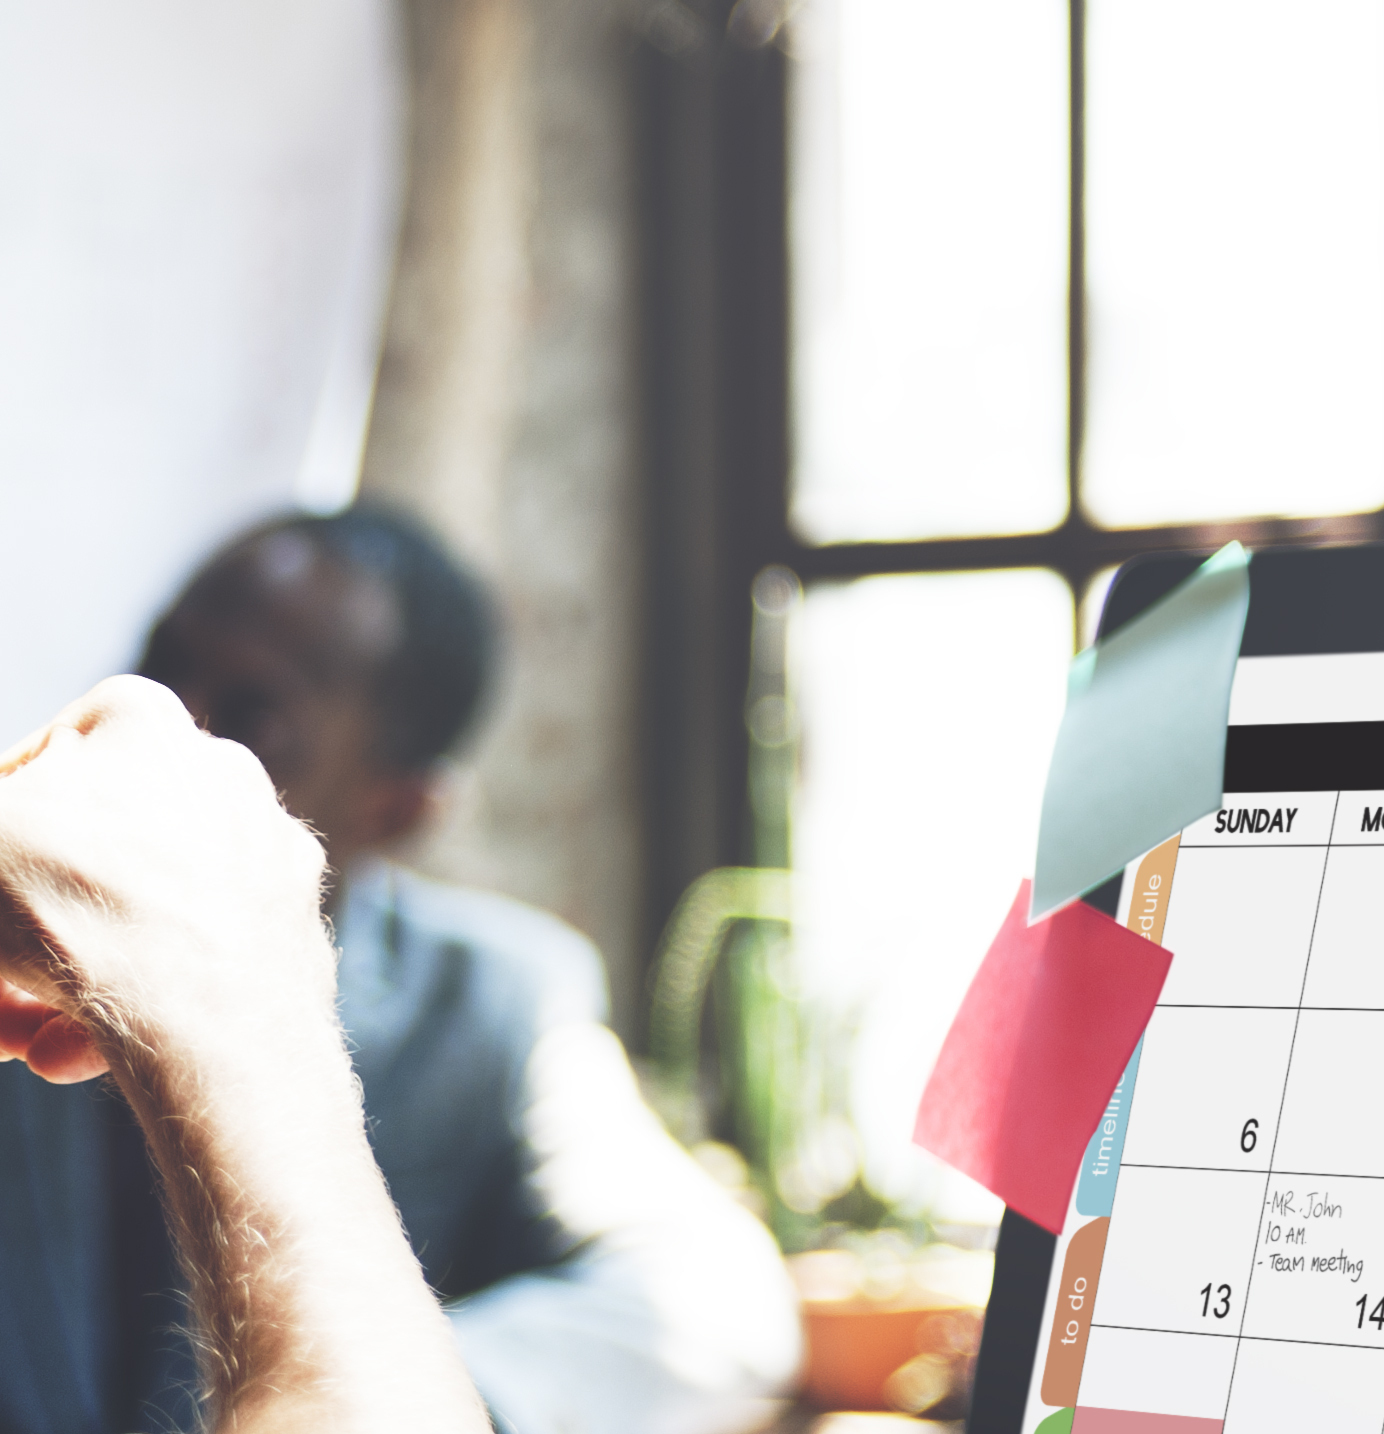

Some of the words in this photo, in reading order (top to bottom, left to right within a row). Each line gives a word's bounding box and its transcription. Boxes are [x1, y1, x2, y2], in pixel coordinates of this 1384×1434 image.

[1214, 808, 1298, 834] SUNDAY
[1240, 1118, 1259, 1153] 6
[1303, 1192, 1342, 1219] John
[1265, 1220, 1281, 1244] 10
[1310, 1248, 1364, 1283] meeting
[1069, 1277, 1087, 1311] do
[1200, 1282, 1232, 1319] 13
[1060, 1319, 1079, 1345] to
